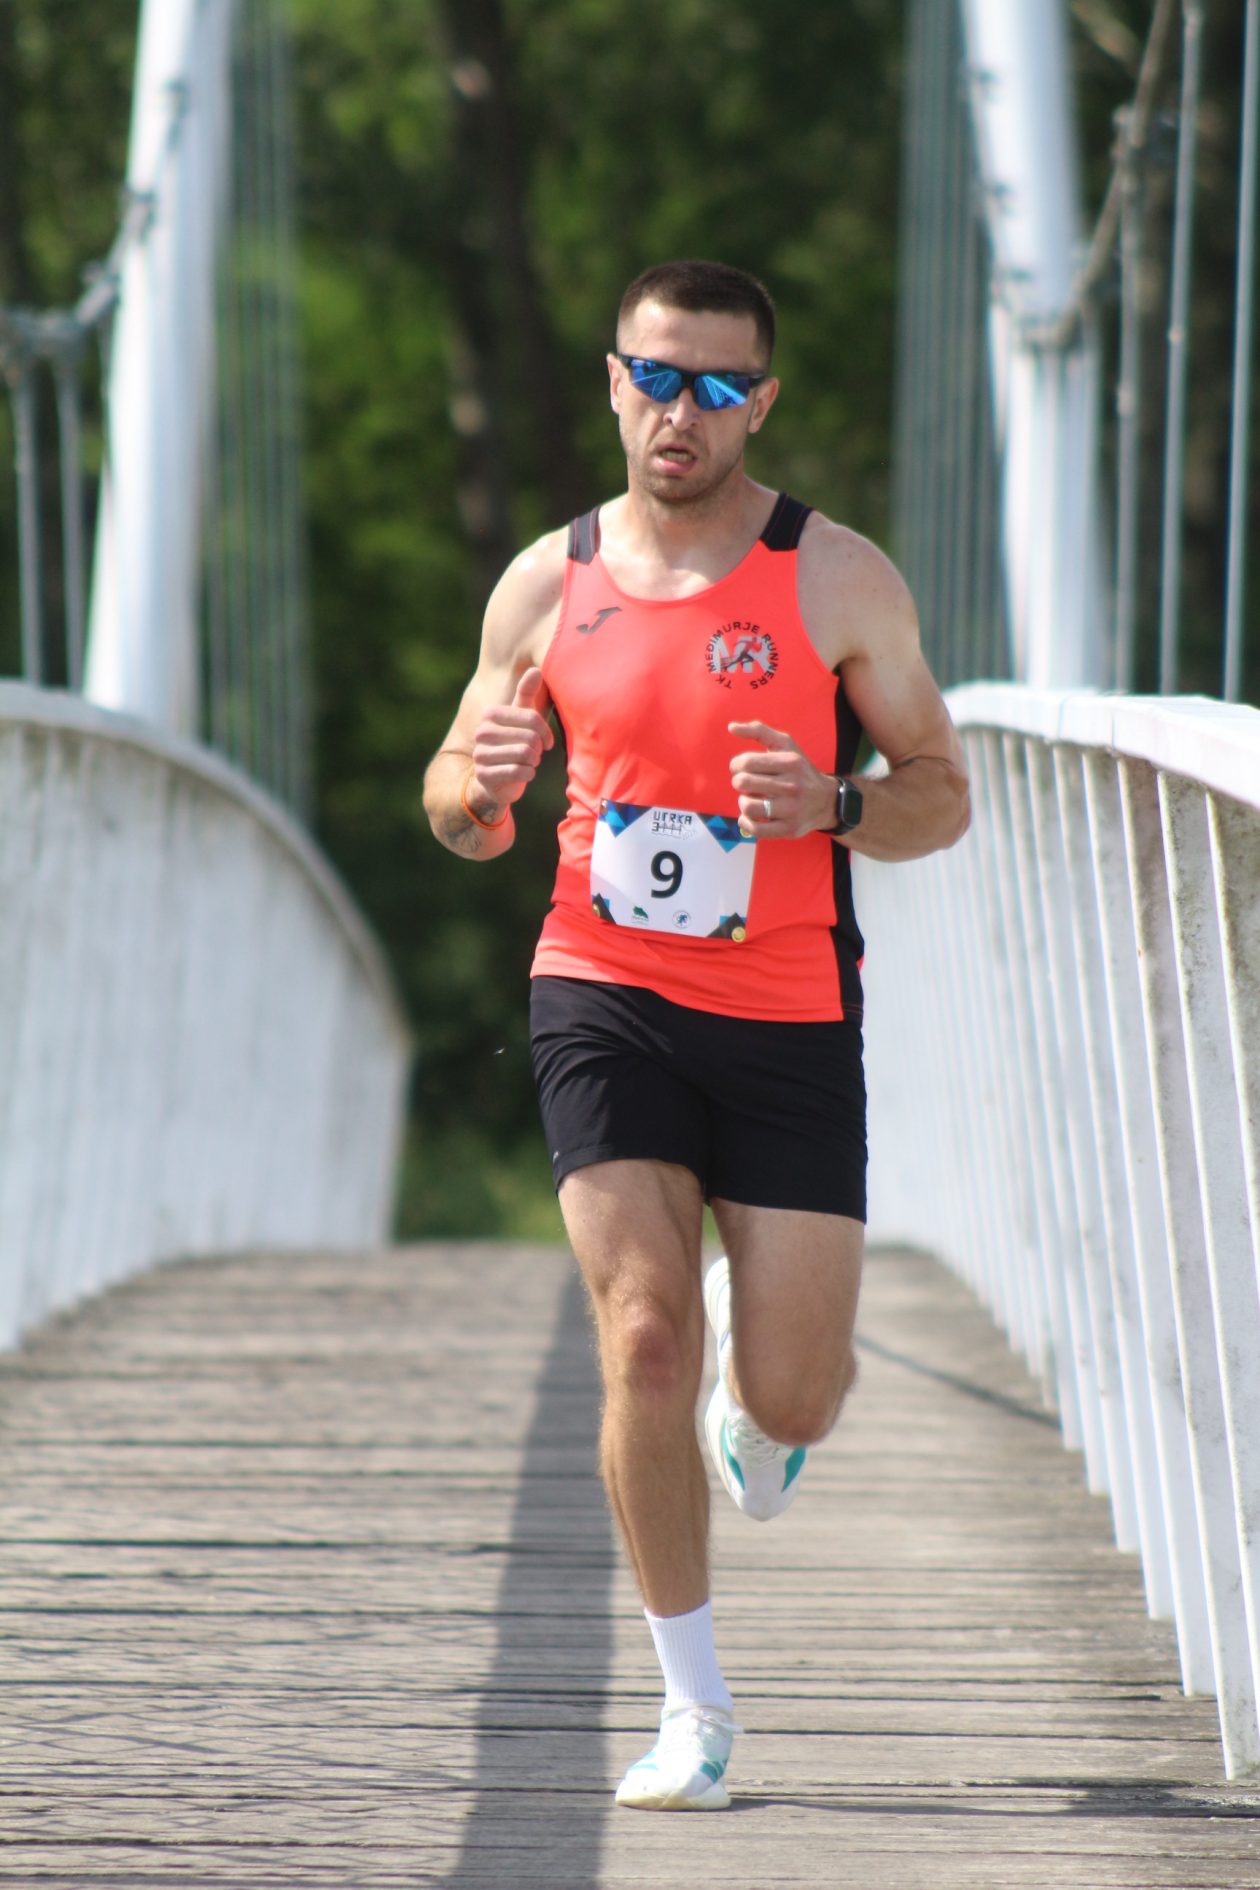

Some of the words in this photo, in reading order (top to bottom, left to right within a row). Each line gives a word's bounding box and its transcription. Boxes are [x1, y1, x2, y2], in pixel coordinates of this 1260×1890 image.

[715, 674, 732, 689] TK
[749, 633, 779, 690] RUNNERS
[650, 850, 684, 899] 9
